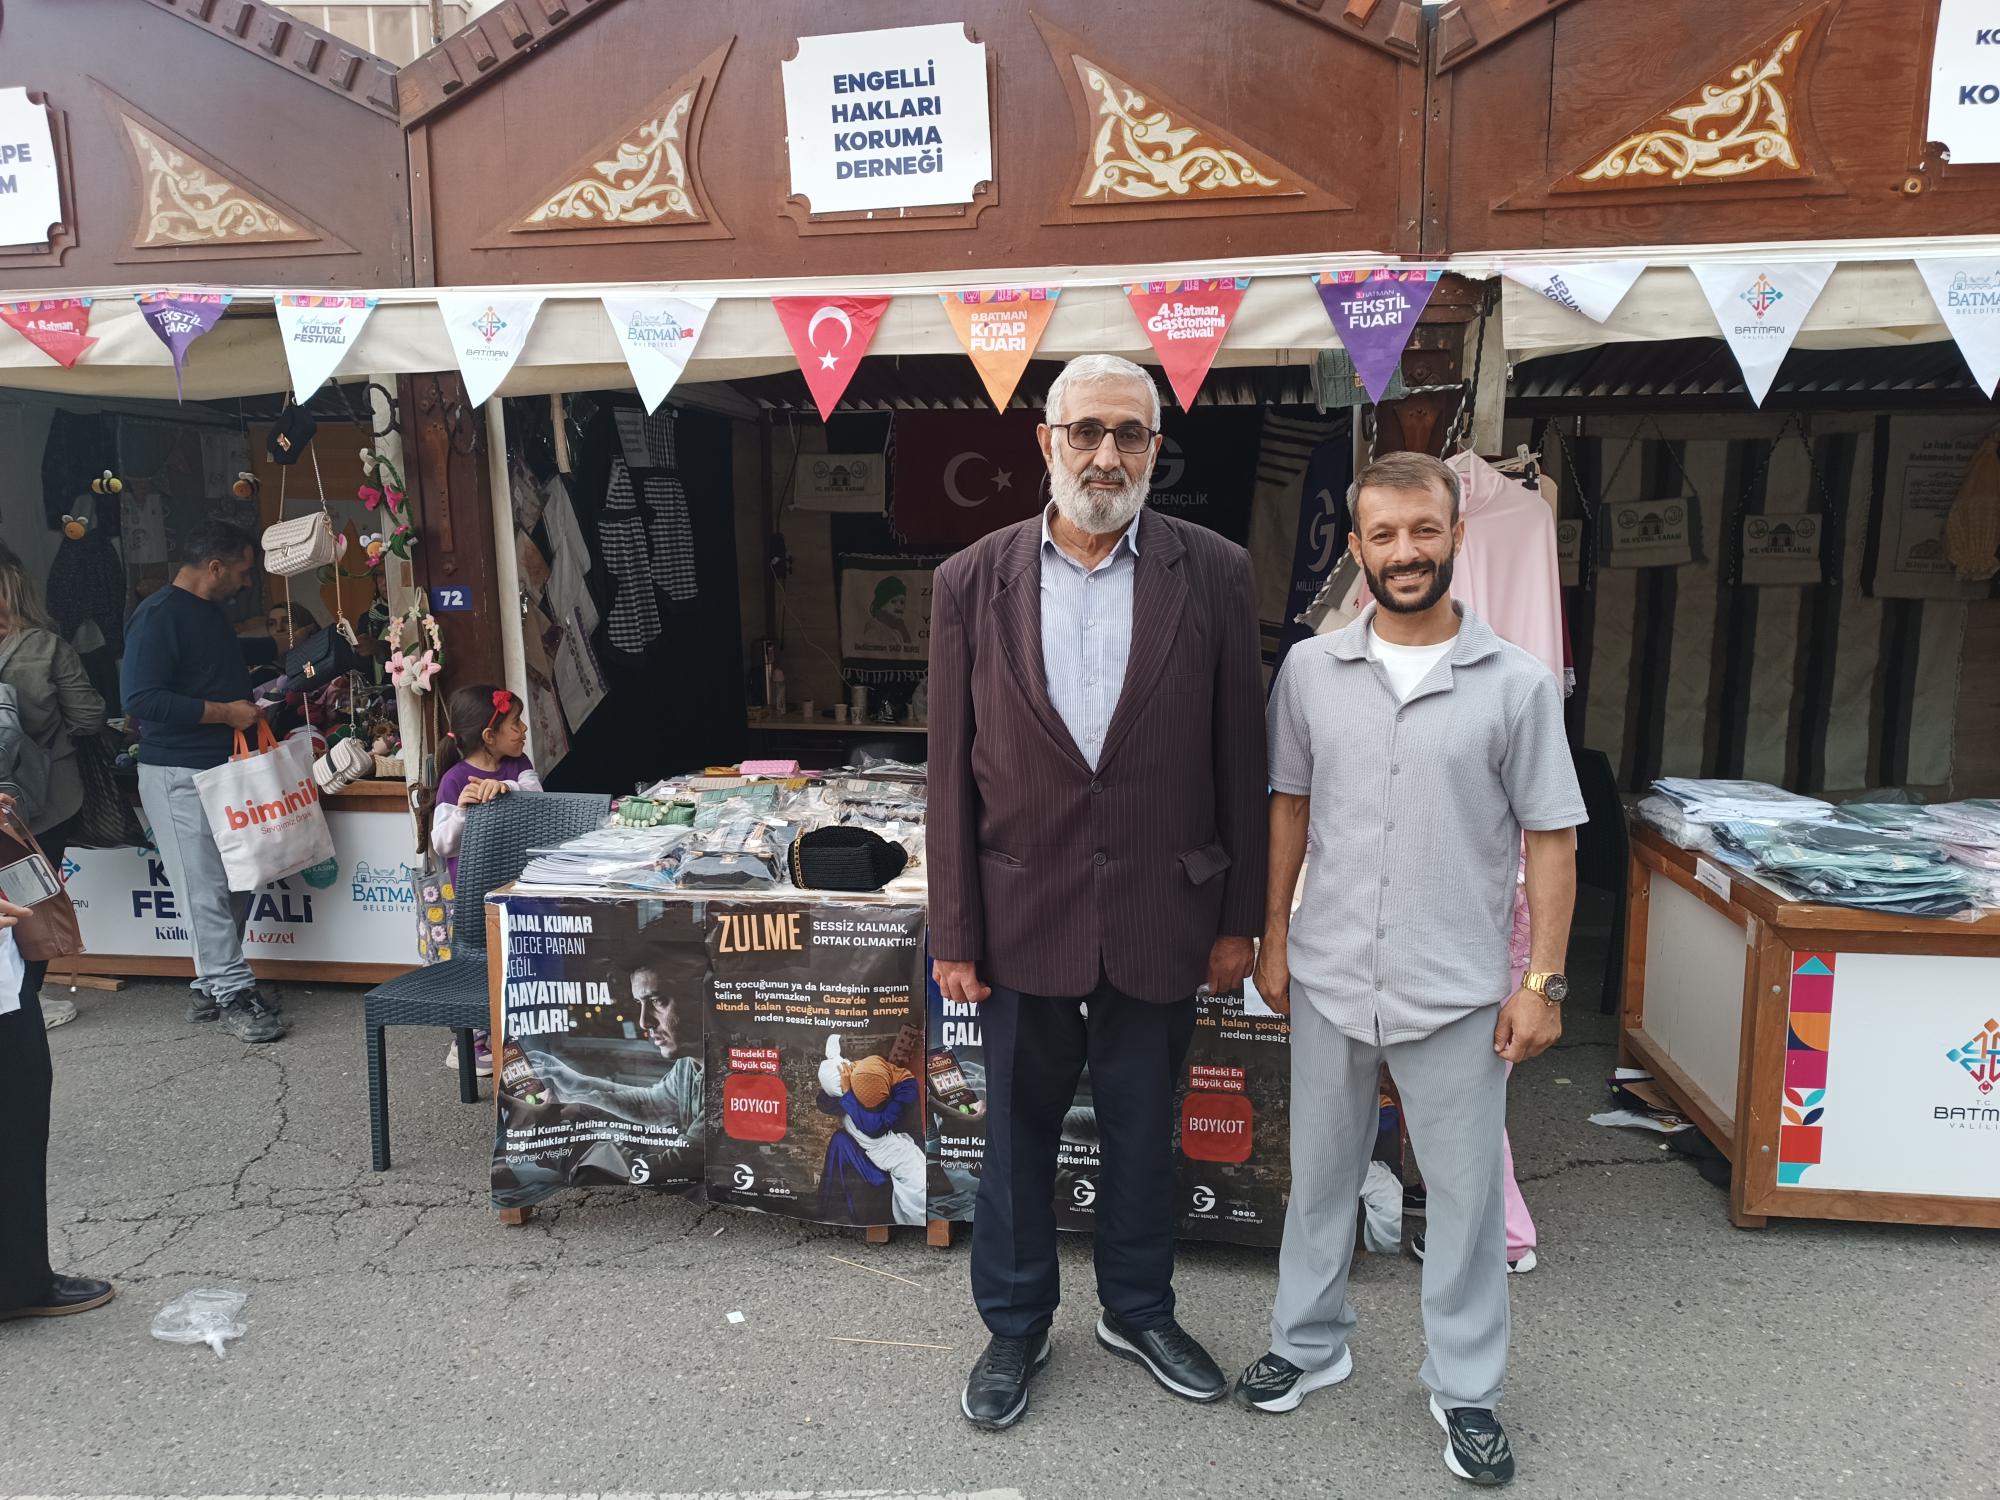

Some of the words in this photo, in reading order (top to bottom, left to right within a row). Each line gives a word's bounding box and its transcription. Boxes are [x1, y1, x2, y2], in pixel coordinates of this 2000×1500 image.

[833, 59, 935, 94] ENGELLİ
[831, 96, 941, 123] HAKLARI
[834, 126, 943, 152] KORUMA
[0, 143, 32, 164] PE
[836, 147, 943, 180] DERNEĞİ
[1341, 293, 1411, 315] TEKSTİL
[970, 310, 1027, 321] 9.BATMAN
[1147, 314, 1226, 333] Gastronomi
[1349, 310, 1402, 329] FUARI
[628, 327, 681, 340] BATMAN
[970, 322, 1026, 337] KİTAP
[1167, 328, 1214, 340] festivali
[1734, 326, 1785, 335] BATMAN
[970, 337, 1026, 351] FUARI
[466, 349, 509, 358] BATMAN
[1153, 491, 1209, 508] GENÇLİK
[440, 590, 464, 606] 72
[544, 915, 593, 933] KUMAR
[813, 919, 854, 932] SESSİZ
[856, 923, 908, 934] KALMAK,
[717, 913, 803, 953] ZULME
[813, 935, 850, 946] ORTAK
[852, 936, 917, 947] OLMAKTIR!
[546, 937, 586, 955] PARANI
[507, 981, 582, 1008] HAYATINI
[586, 982, 612, 1005] DA
[714, 980, 732, 989] Sen
[735, 980, 789, 991] çocuğunun
[791, 984, 802, 992] ya
[804, 981, 817, 991] da
[819, 982, 870, 995] kardeşinin
[873, 984, 909, 995] saçının
[714, 991, 743, 1000] teline
[755, 991, 811, 1003] kıyamazken
[823, 994, 866, 1005] Gazze'de
[879, 995, 910, 1004] enkaz
[716, 1002, 750, 1012] altında
[754, 1002, 782, 1012] kalan
[785, 1004, 830, 1016] çocuğuna
[834, 1007, 868, 1016] sarılan
[873, 1007, 910, 1017] anneye
[508, 1009, 570, 1041] ÇALAR!
[754, 1013, 784, 1023] neden
[785, 1015, 813, 1025] sessiz
[814, 1017, 870, 1028] kalıyorsun?
[1221, 1018, 1250, 1028] kalan
[1220, 1029, 1252, 1040] neden
[1255, 1034, 1287, 1044] sessiz
[731, 1049, 765, 1058] Elindeki
[766, 1050, 778, 1058] En
[732, 1060, 758, 1070] Büyük
[760, 1061, 777, 1072] Güç
[1192, 1066, 1229, 1077] Elindeki
[1231, 1068, 1243, 1077] En
[1192, 1079, 1222, 1088] Büyük
[1223, 1080, 1242, 1090] Güç
[730, 1098, 780, 1115] BOYKOT
[506, 1128, 536, 1138] Sanal
[538, 1124, 574, 1136] Kumar,
[576, 1119, 607, 1130] intihar
[609, 1122, 632, 1131] oranı
[644, 1125, 679, 1137] yüksek
[1189, 1117, 1245, 1134] BOYKOT
[506, 1136, 568, 1152] bağımlılıklar
[570, 1132, 612, 1143] arasında
[613, 1132, 690, 1148] gösterilmektedir.
[941, 1135, 969, 1146] Sanal
[1074, 1145, 1087, 1153] en
[505, 1147, 574, 1165] Kaynak/Yeşilay
